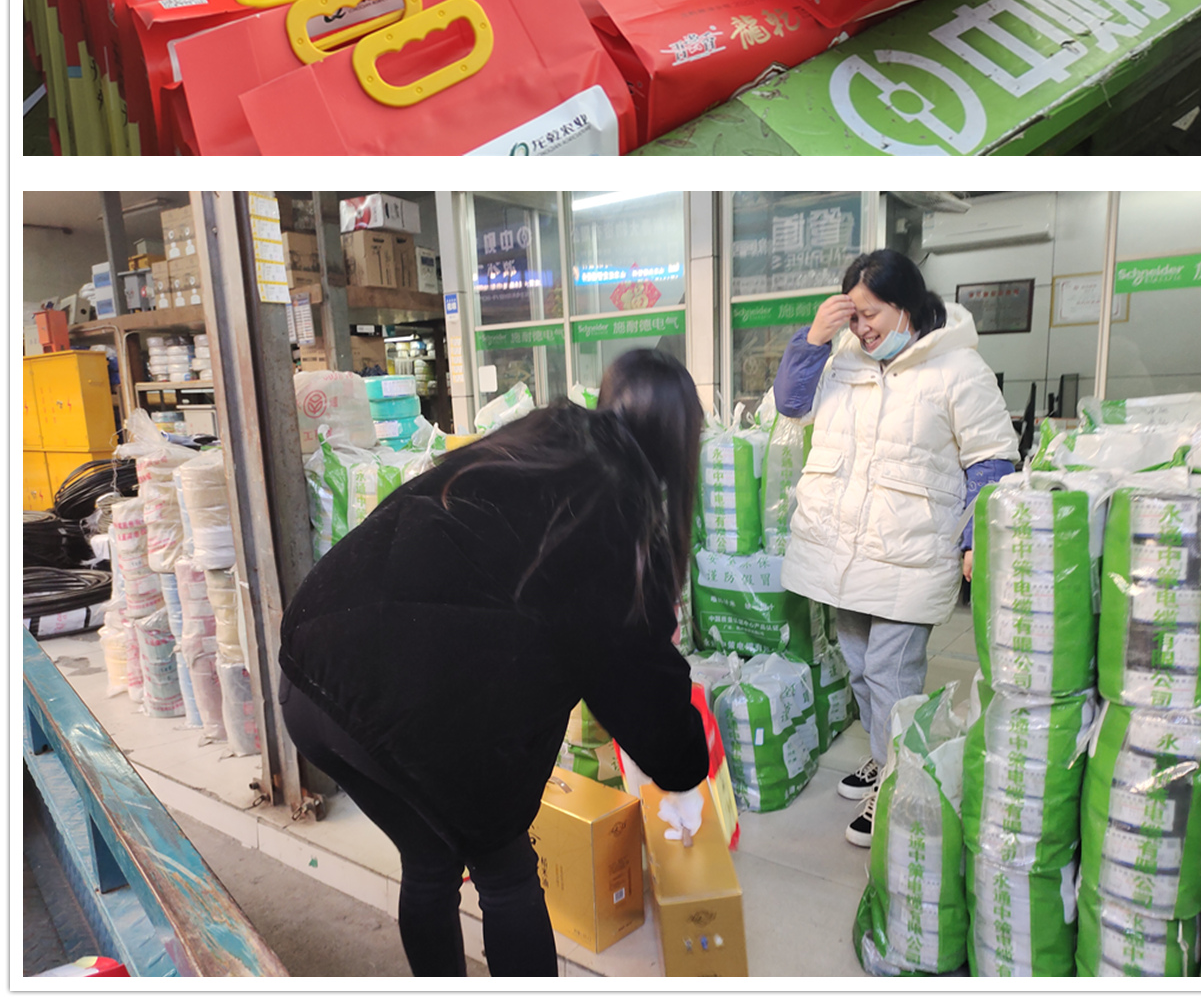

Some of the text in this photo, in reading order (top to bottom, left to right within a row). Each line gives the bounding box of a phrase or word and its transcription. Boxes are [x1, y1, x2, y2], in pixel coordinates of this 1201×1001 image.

[1117, 263, 1185, 287] Schneider
[577, 315, 680, 337] Schneider 施耐德电气
